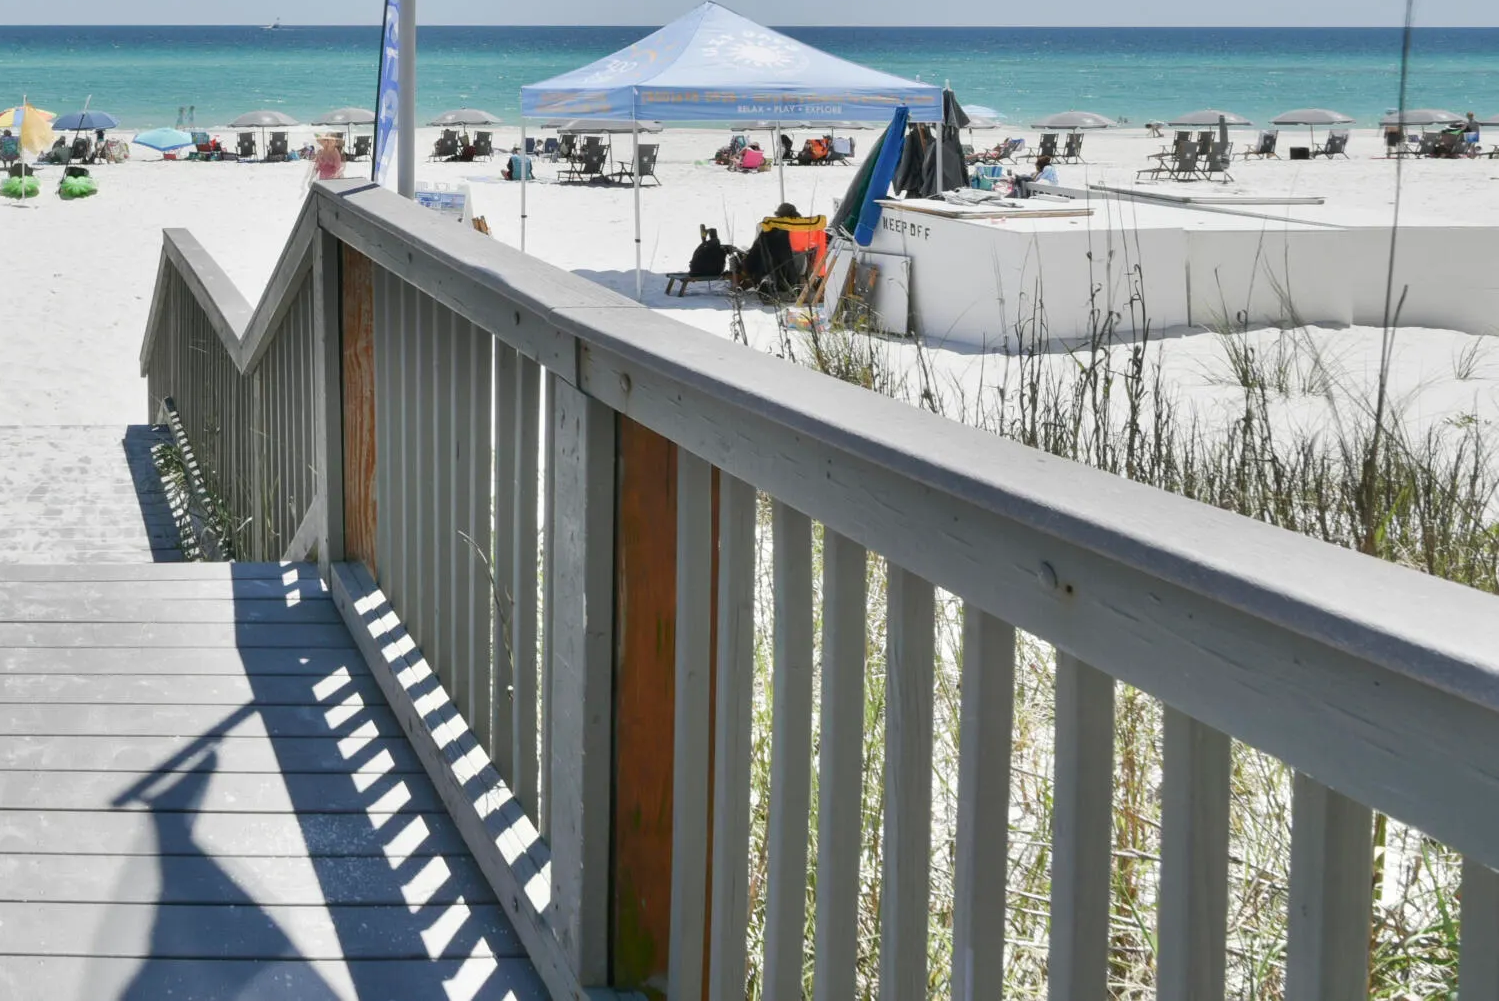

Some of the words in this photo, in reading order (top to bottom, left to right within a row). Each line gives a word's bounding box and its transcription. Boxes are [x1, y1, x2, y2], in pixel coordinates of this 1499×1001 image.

[736, 105, 764, 114] RELAX
[773, 105, 796, 114] PLAY
[804, 105, 843, 114] EXPLORE
[882, 216, 907, 234] KEEP
[910, 222, 931, 240] OFF
